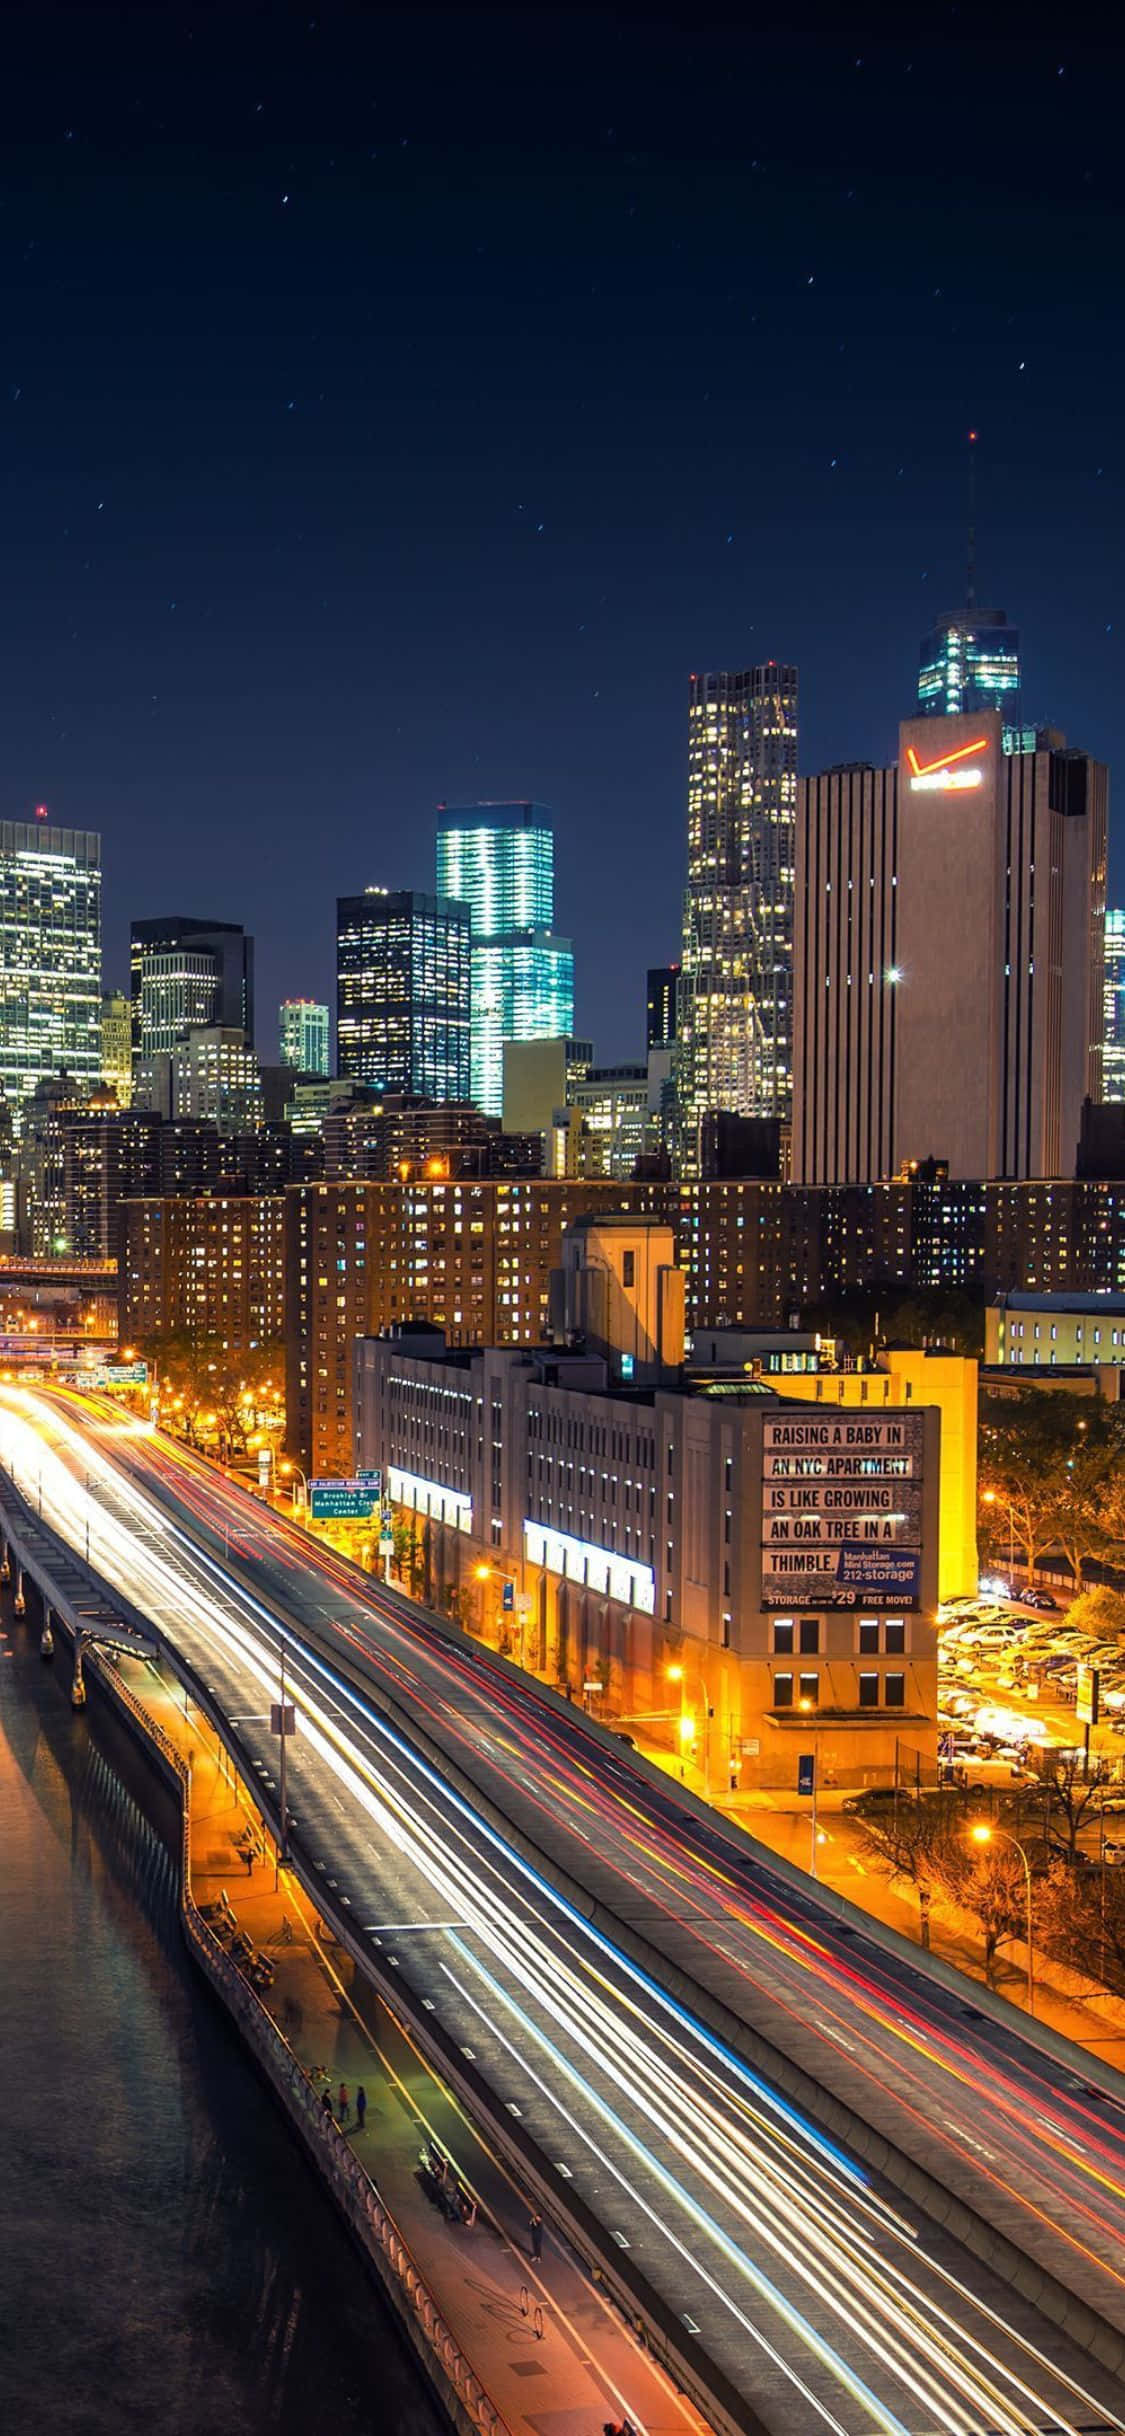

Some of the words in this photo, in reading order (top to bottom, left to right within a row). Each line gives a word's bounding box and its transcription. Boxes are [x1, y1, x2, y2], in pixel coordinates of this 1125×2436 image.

[773, 1427, 828, 1444] RAISING
[833, 1428, 842, 1443] A
[847, 1428, 882, 1443] BABY
[888, 1428, 900, 1442] IN
[772, 1458, 791, 1475] AN
[795, 1458, 821, 1474] NYC
[827, 1458, 908, 1474] APARTMENT
[772, 1491, 784, 1507] IS
[790, 1491, 819, 1507] LIKE
[824, 1491, 889, 1507] GROWING
[771, 1522, 788, 1538] AN
[794, 1521, 821, 1538] OAK
[826, 1521, 859, 1538] TREE
[865, 1522, 878, 1538] IN
[883, 1522, 892, 1538] A
[771, 1555, 835, 1572] THIMBLE.
[844, 1551, 890, 1560] Manhattan
[768, 1596, 810, 1605] STORAGE
[832, 1592, 856, 1604] $29
[863, 1596, 884, 1604] FREE
